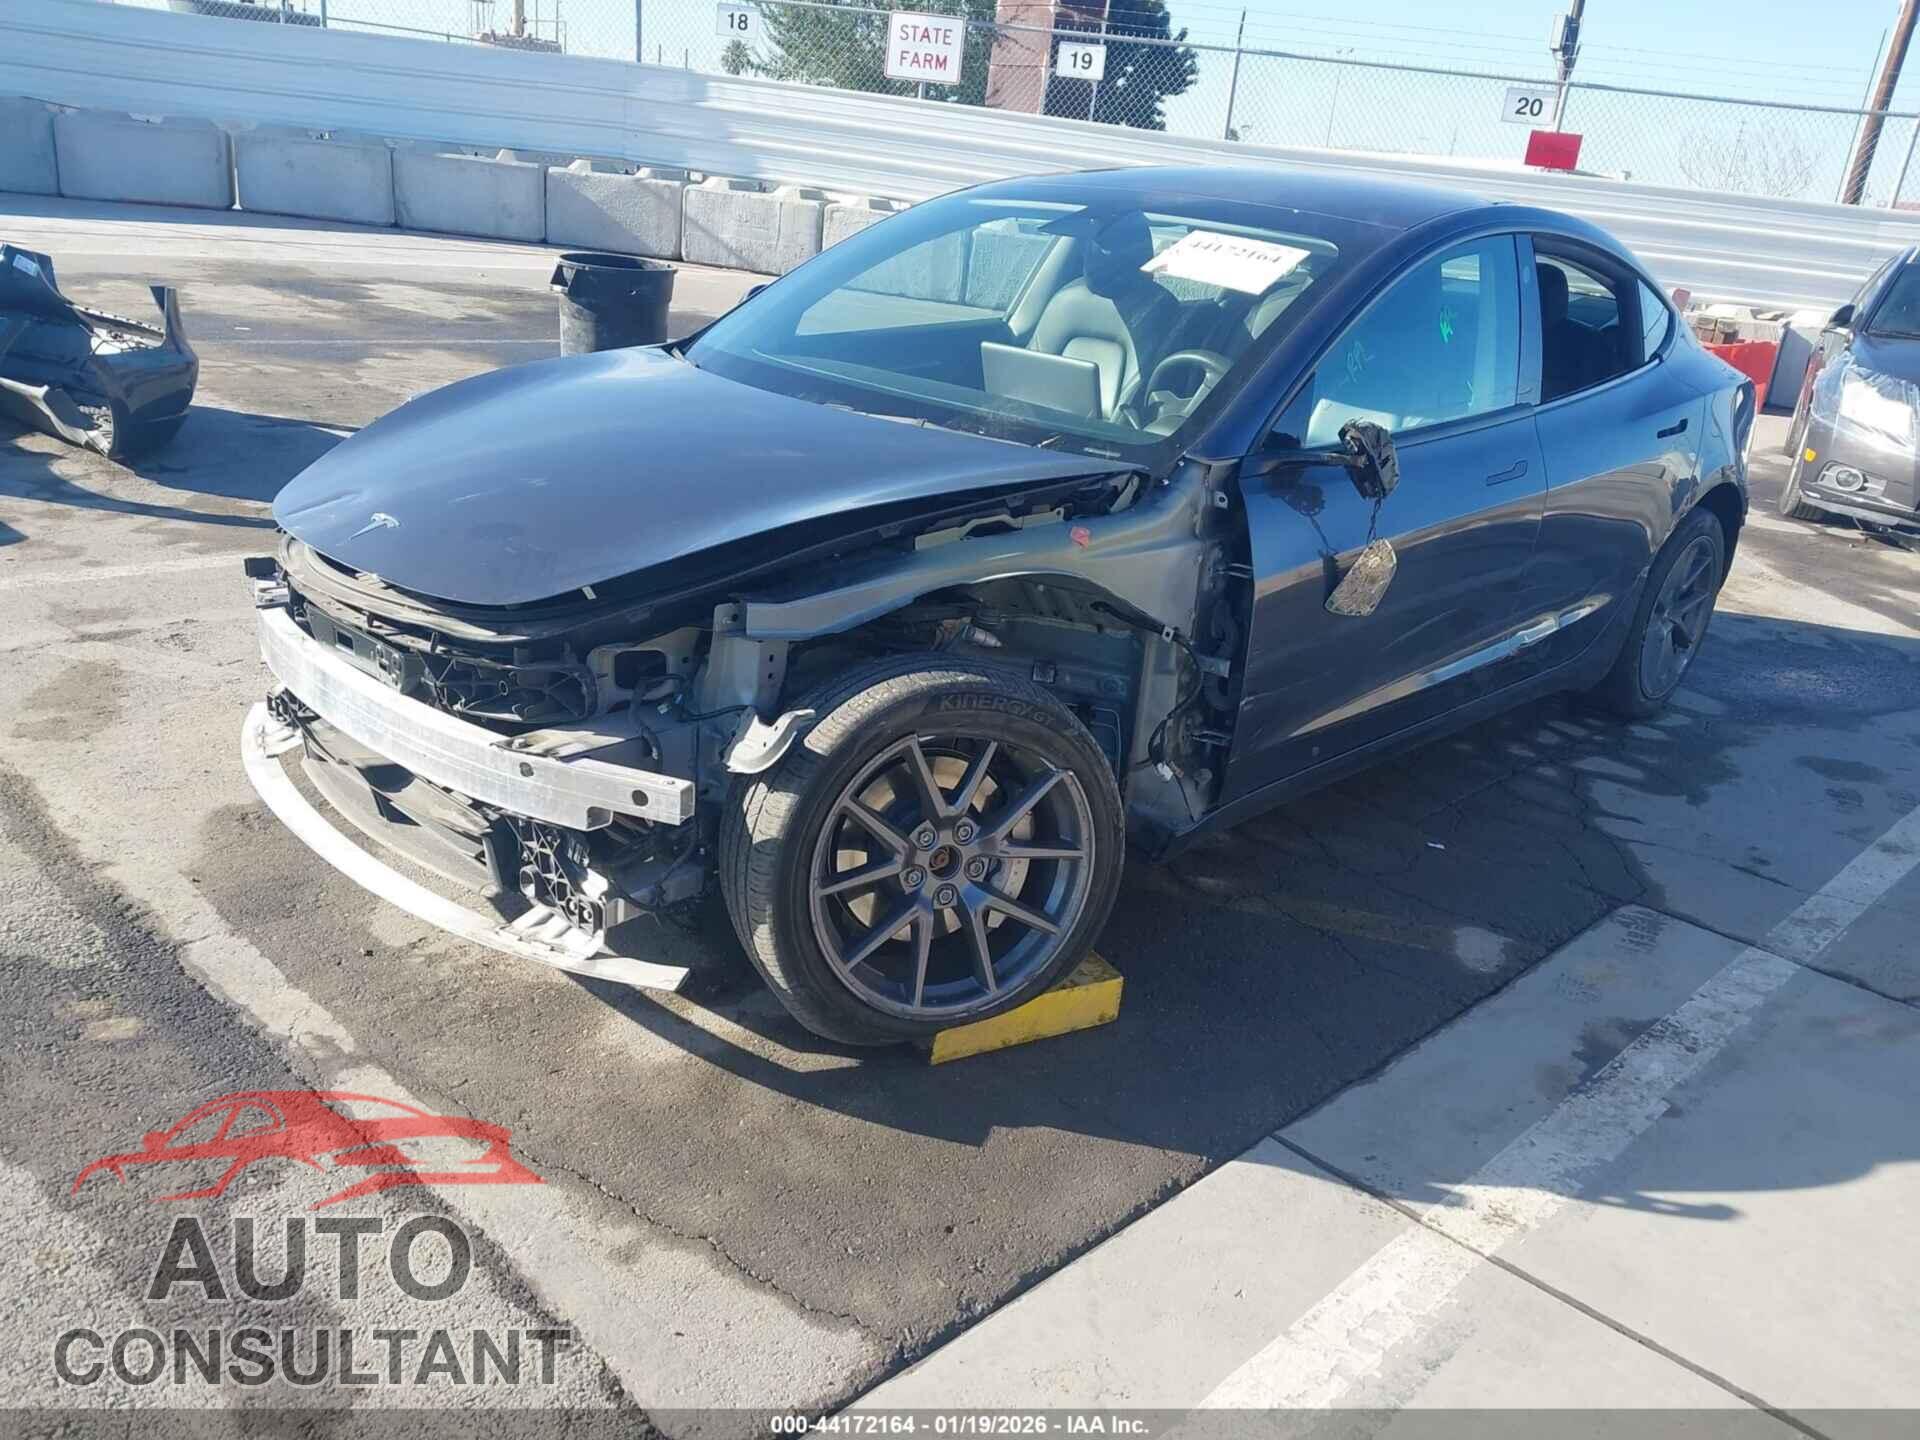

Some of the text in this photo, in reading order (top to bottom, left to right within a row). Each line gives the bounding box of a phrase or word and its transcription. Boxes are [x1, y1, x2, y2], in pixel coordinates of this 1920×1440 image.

[727, 12, 748, 31] 18
[899, 23, 953, 46] STATE
[899, 50, 948, 72] FARM
[1070, 51, 1093, 71] 19
[1515, 96, 1543, 117] 20
